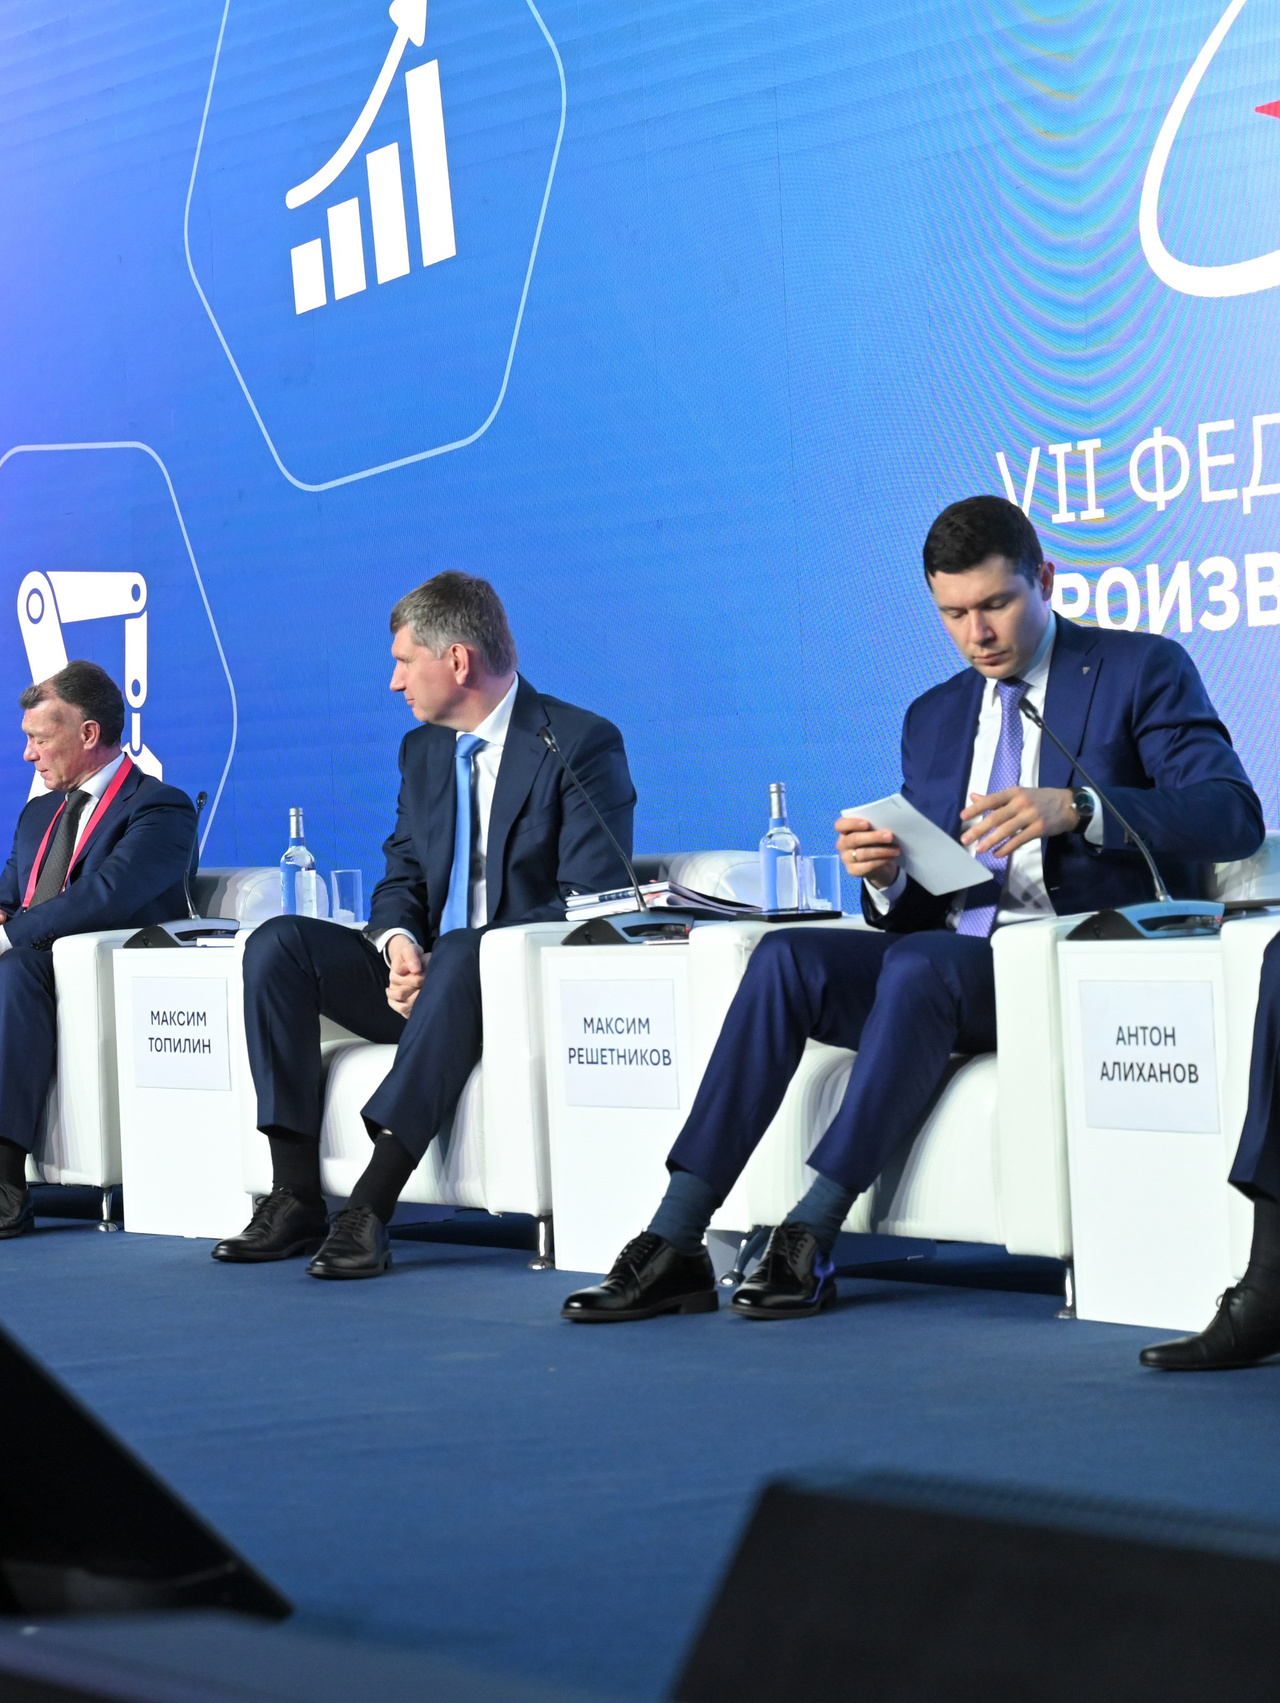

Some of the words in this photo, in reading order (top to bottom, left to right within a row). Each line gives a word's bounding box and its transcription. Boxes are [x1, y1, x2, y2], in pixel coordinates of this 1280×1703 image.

[996, 438, 1105, 523] VII
[1129, 413, 1280, 514] ФЕД
[1051, 551, 1280, 634] РОИЗВ
[150, 1010, 207, 1026] МАКСИМ
[583, 1017, 650, 1034] МАКСИМ
[148, 1037, 211, 1054] ТОПИЛИН
[1116, 1026, 1176, 1046] АНТОН
[568, 1047, 672, 1066] РЕШЕТНИКОВ
[1100, 1061, 1199, 1083] АЛИХАНОВ
